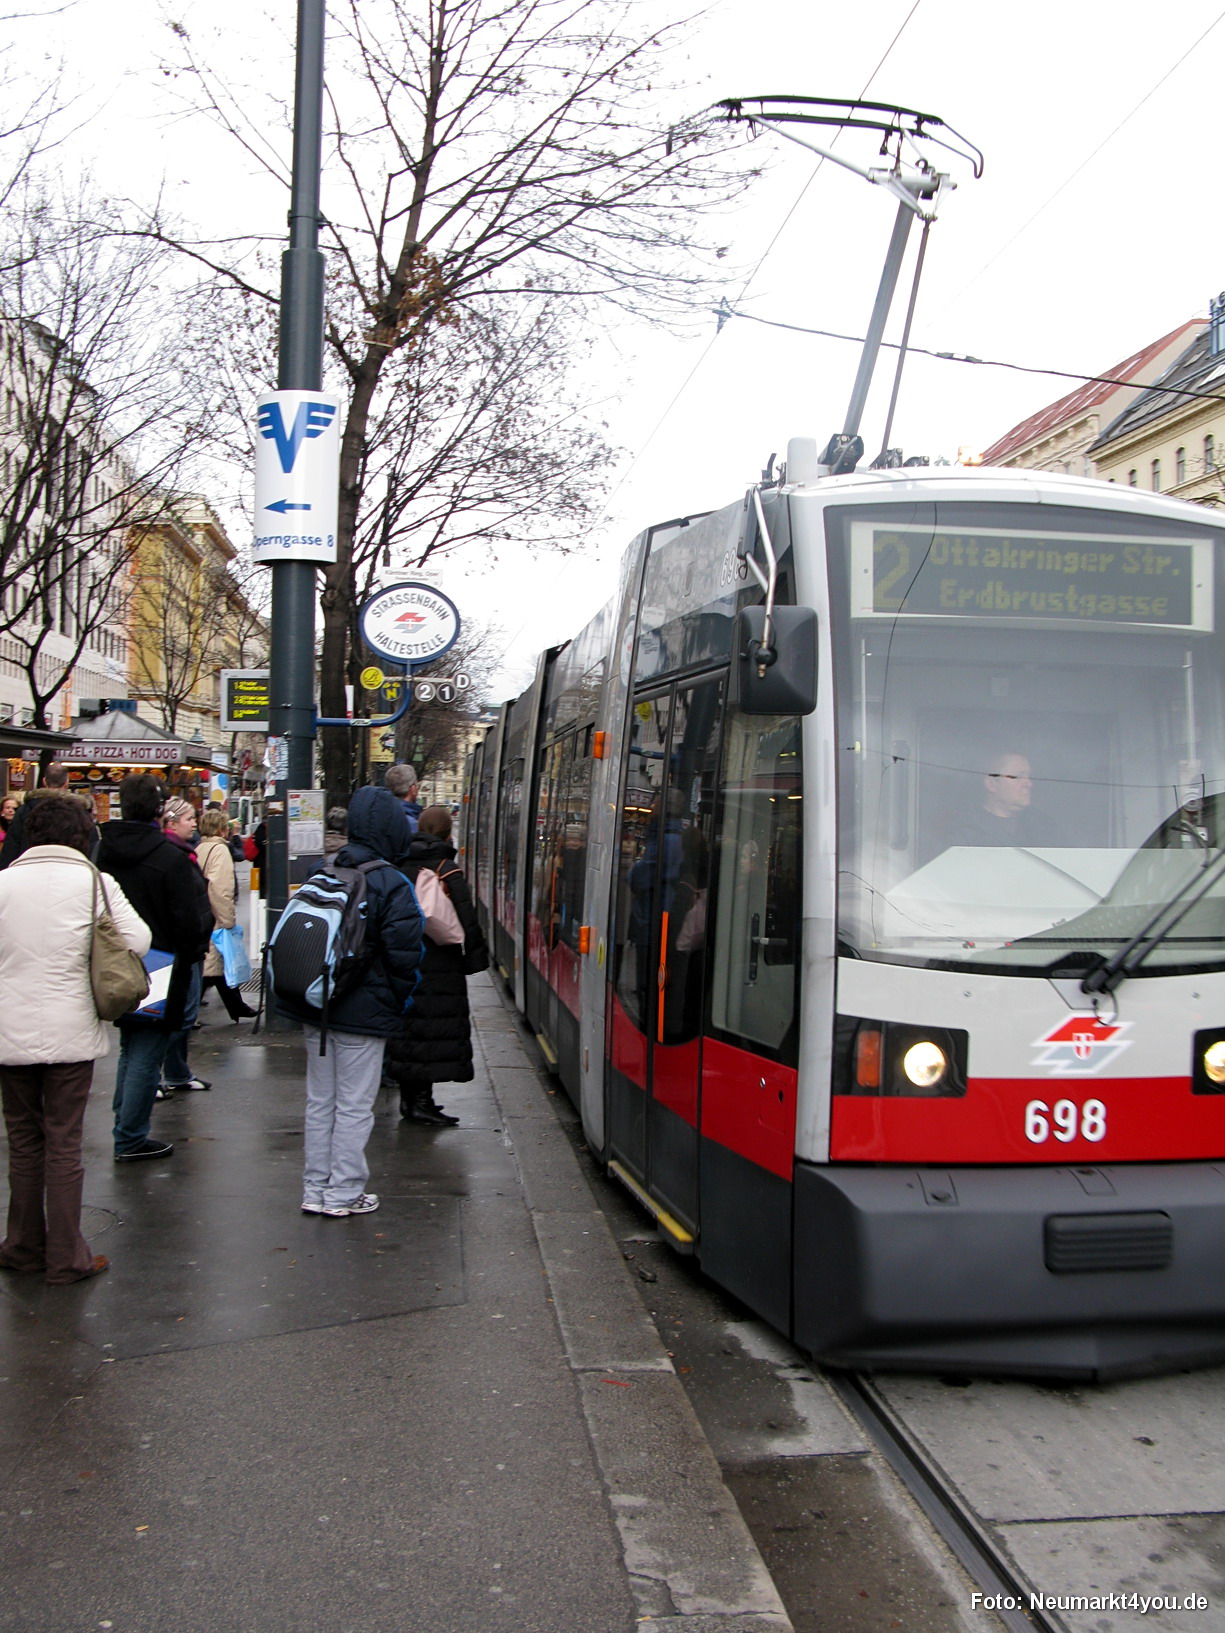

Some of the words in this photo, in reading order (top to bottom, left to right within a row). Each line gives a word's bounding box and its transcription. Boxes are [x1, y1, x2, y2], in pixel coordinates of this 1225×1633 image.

[326, 534, 334, 548] 8
[872, 535, 911, 610] 2
[929, 534, 1115, 574] Ottakringer
[1121, 545, 1181, 576] Str.
[372, 593, 450, 621] STRASSENBAHN
[938, 577, 1168, 617] Erdbrustgasse
[374, 631, 446, 656] HALTESTELLE
[457, 674, 469, 688] D
[386, 687, 397, 700] N
[419, 684, 431, 699] 2
[441, 686, 451, 700] 1
[93, 746, 124, 759] PIZZA
[130, 747, 152, 759] HOT
[155, 747, 177, 760] DOG
[1025, 1098, 1107, 1144] 698
